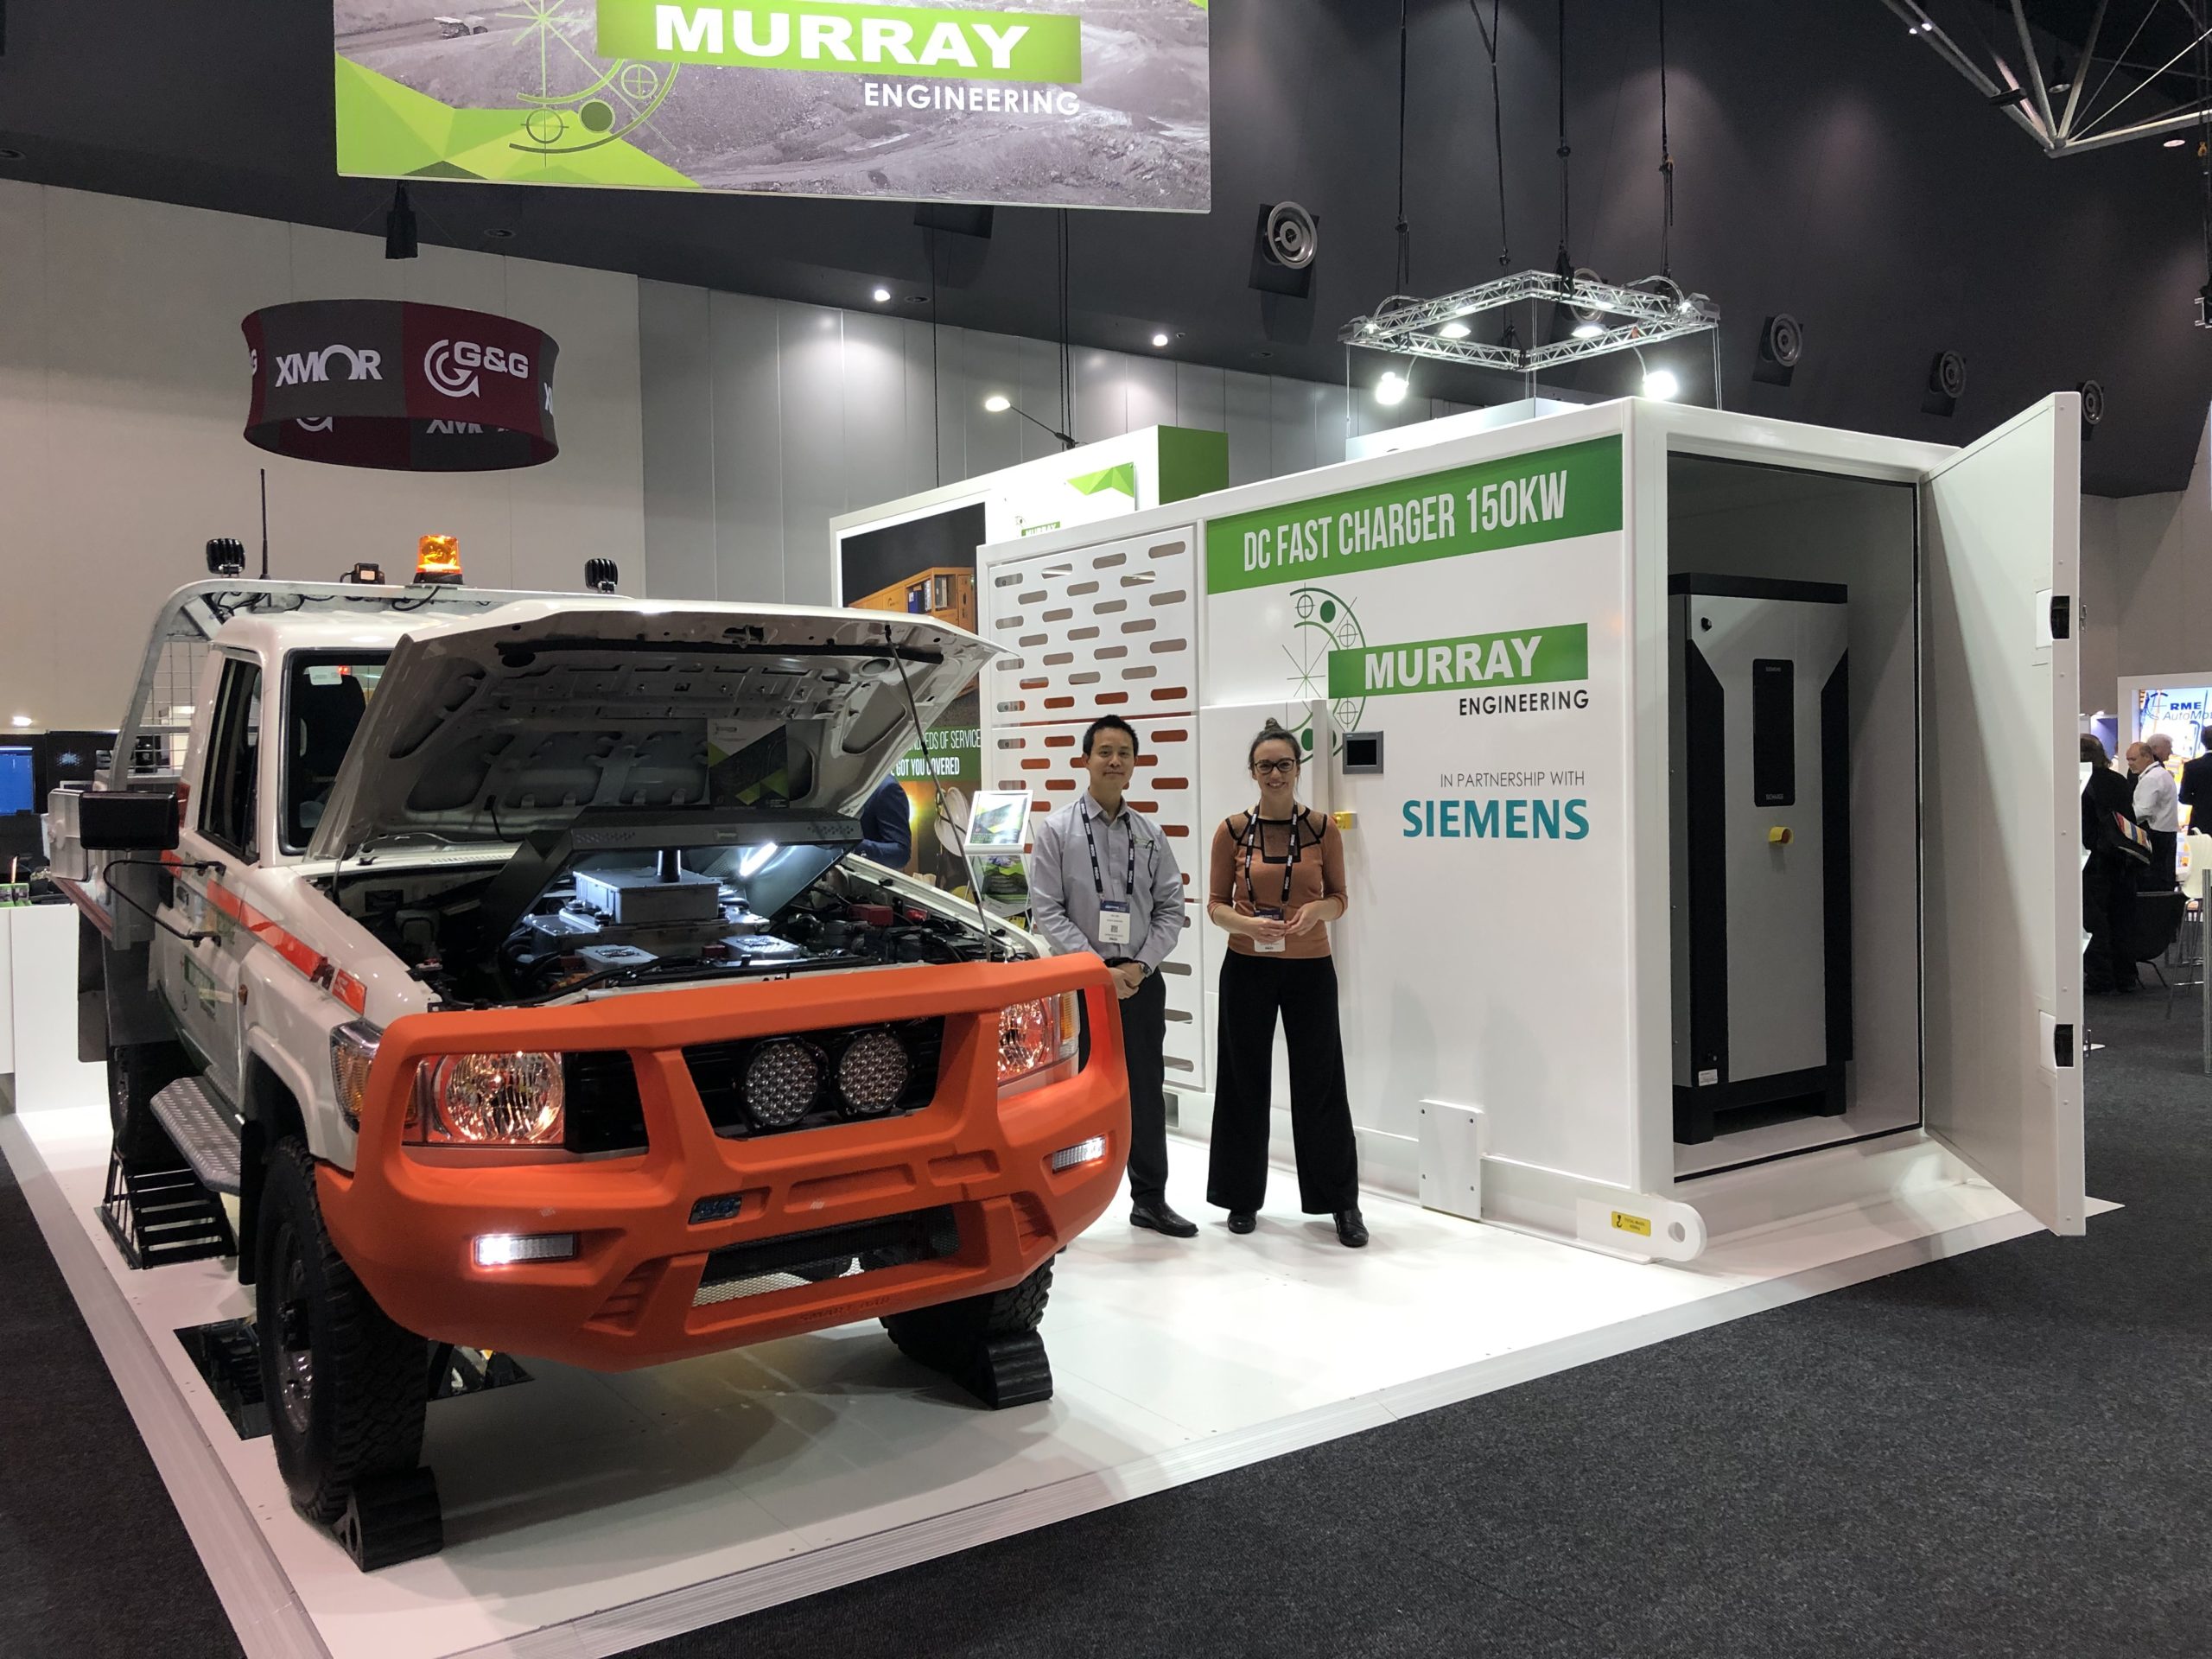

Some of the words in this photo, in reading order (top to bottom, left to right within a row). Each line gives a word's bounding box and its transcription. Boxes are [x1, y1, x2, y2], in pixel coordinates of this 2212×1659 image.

[657, 4, 1030, 69] MURRAY
[864, 83, 1080, 116] ENGINEERING
[275, 344, 383, 387] XMOR
[454, 340, 529, 378] G&G
[1244, 529, 1271, 572] DC
[1277, 516, 1332, 566] FAST
[1338, 493, 1455, 556] CHARGER
[1466, 470, 1567, 534] 150KW
[1365, 635, 1542, 690] MURRAY
[1459, 690, 1589, 715] ENGINEERING
[2170, 702, 2202, 710] RME
[939, 732, 950, 749] OF
[896, 759, 910, 776] GOT
[911, 758, 925, 776] YOU
[1440, 773, 1453, 787] IN
[1457, 772, 1545, 787] PARTNERSHIP
[1549, 771, 1585, 786] WITH
[1402, 798, 1590, 840] SIEMENS
